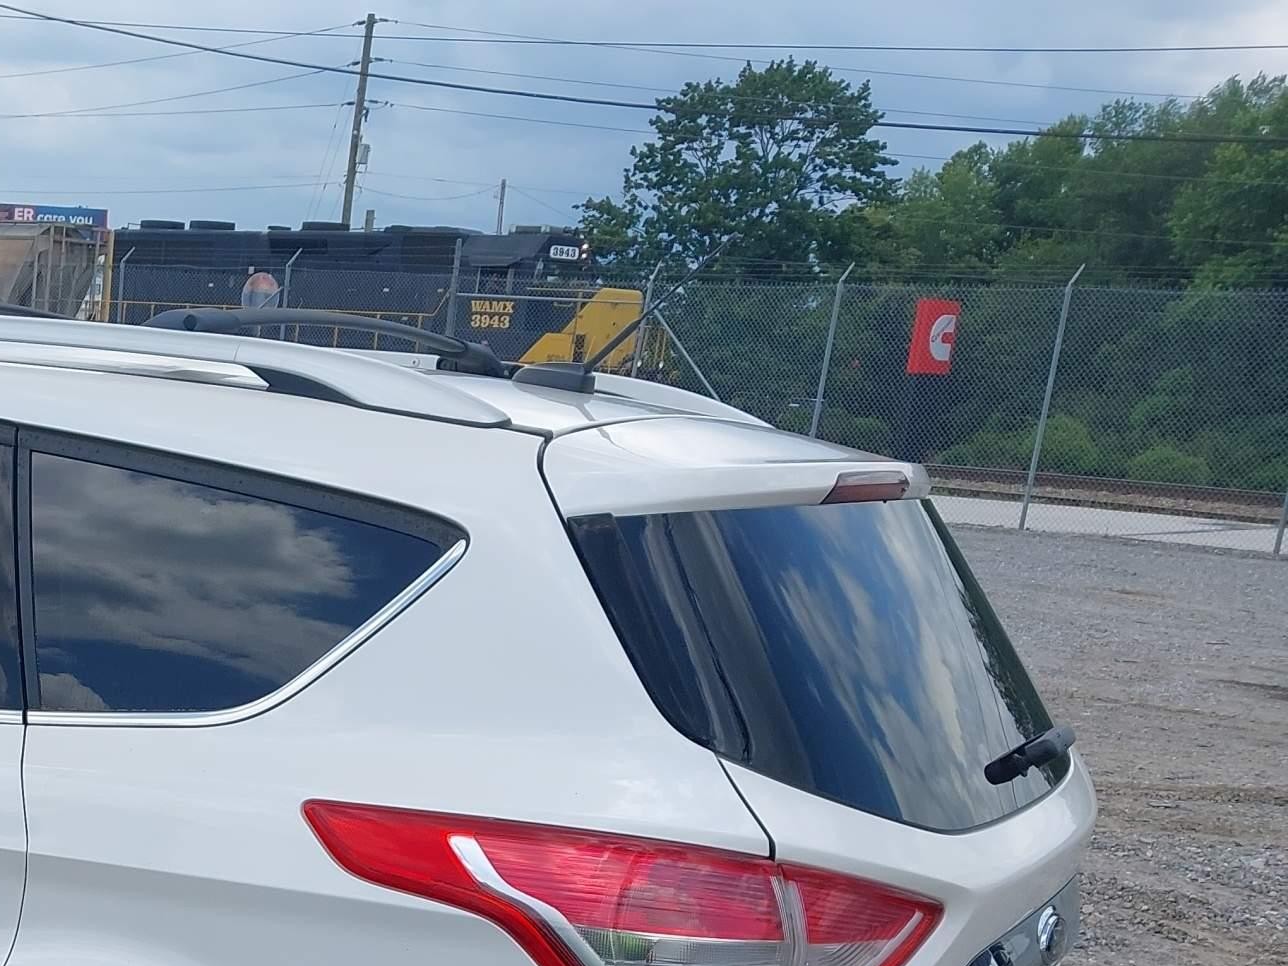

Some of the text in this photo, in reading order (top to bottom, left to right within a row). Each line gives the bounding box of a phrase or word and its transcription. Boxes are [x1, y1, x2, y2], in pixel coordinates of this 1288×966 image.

[14, 207, 34, 220] ER
[551, 246, 577, 258] 3943
[471, 300, 514, 314] WAMX
[471, 314, 510, 329] 3943
